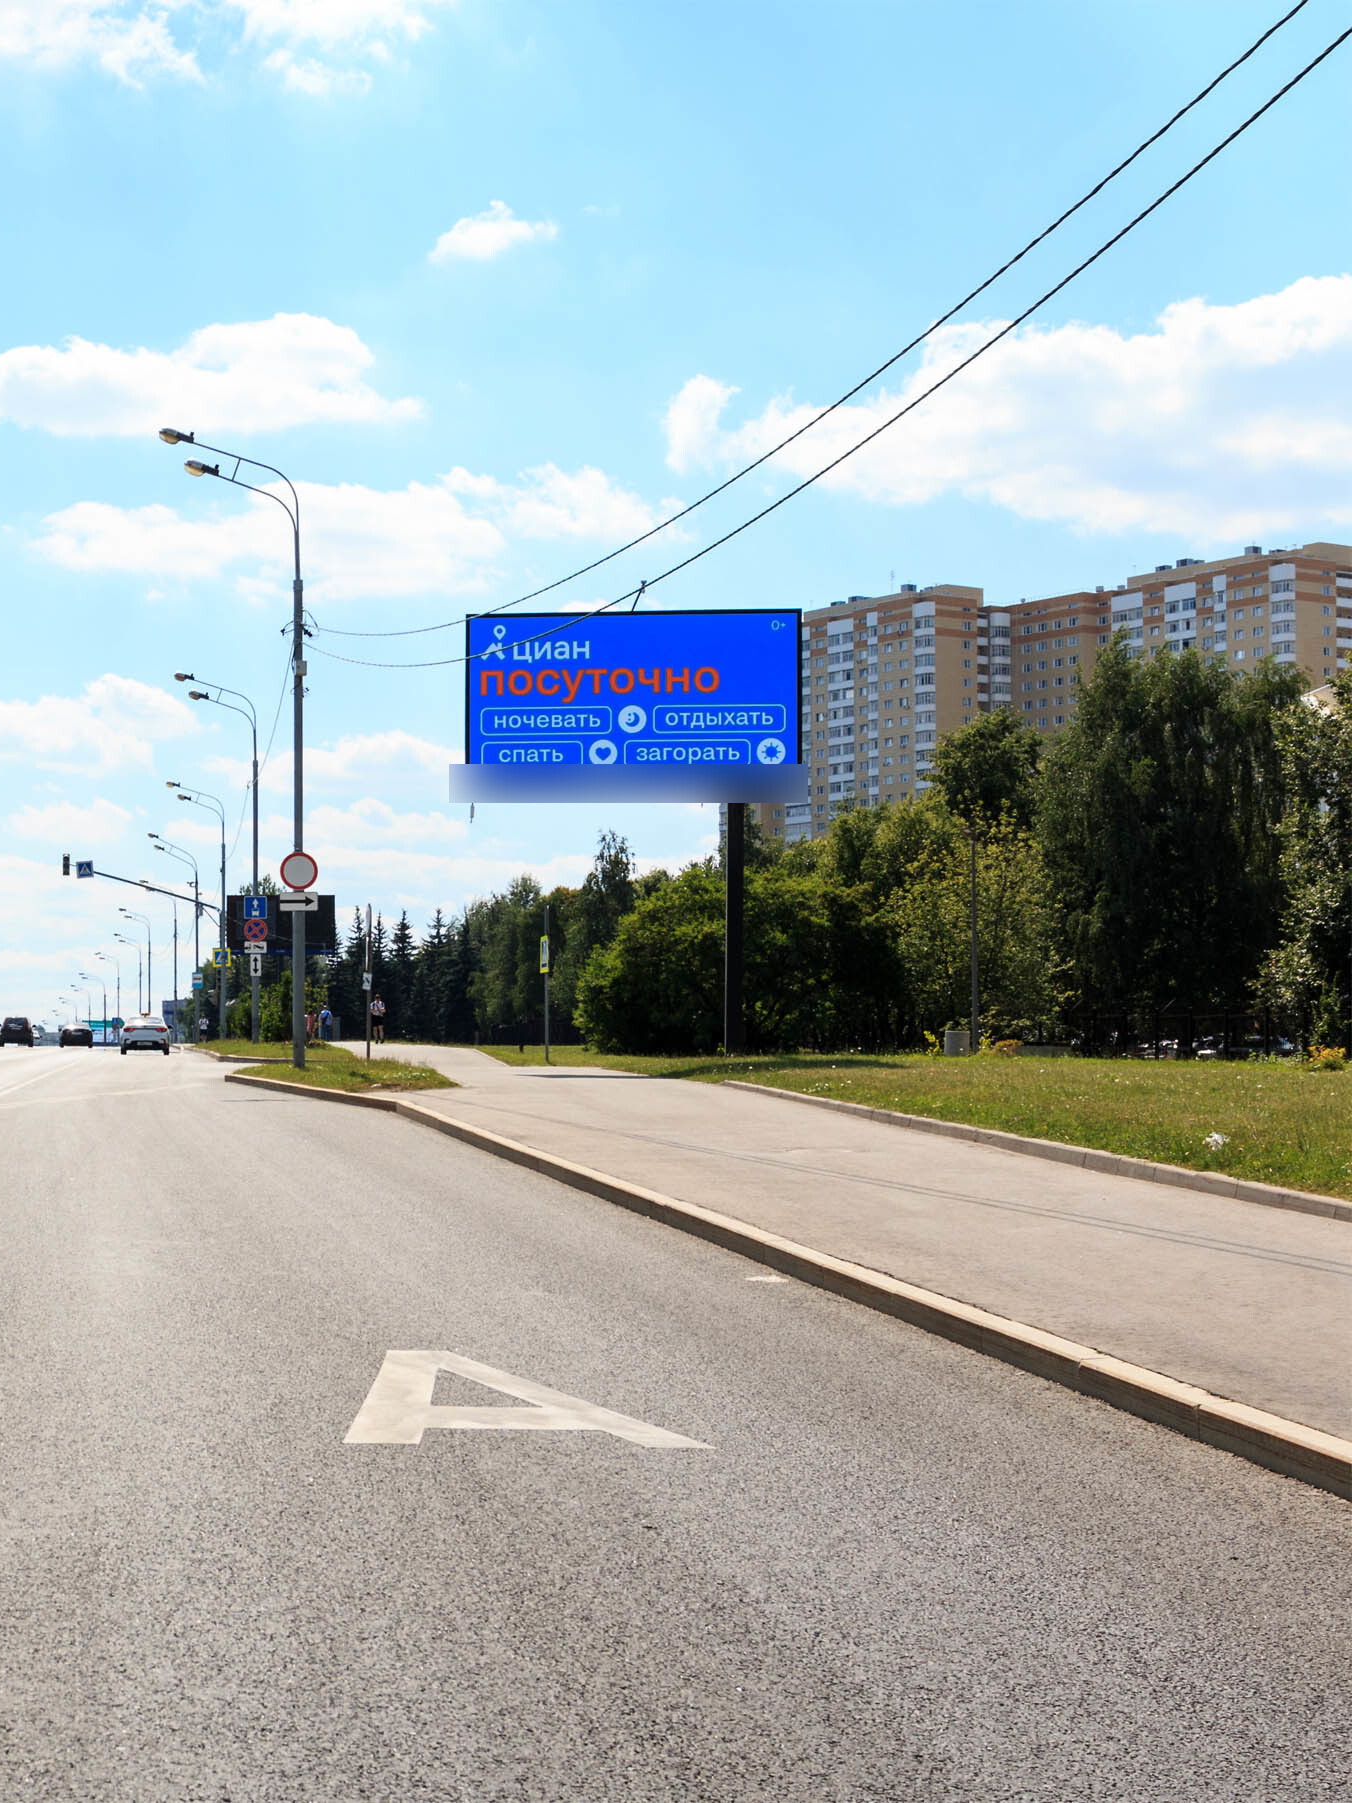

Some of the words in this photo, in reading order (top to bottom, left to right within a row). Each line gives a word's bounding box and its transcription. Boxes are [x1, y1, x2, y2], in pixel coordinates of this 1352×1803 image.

[770, 620, 786, 631] 0+
[512, 640, 590, 664] циан
[480, 666, 720, 704] посуточно
[494, 712, 601, 729] ночевать
[665, 709, 774, 729] отдыхать
[498, 747, 564, 763] спать
[636, 744, 741, 764] загорать
